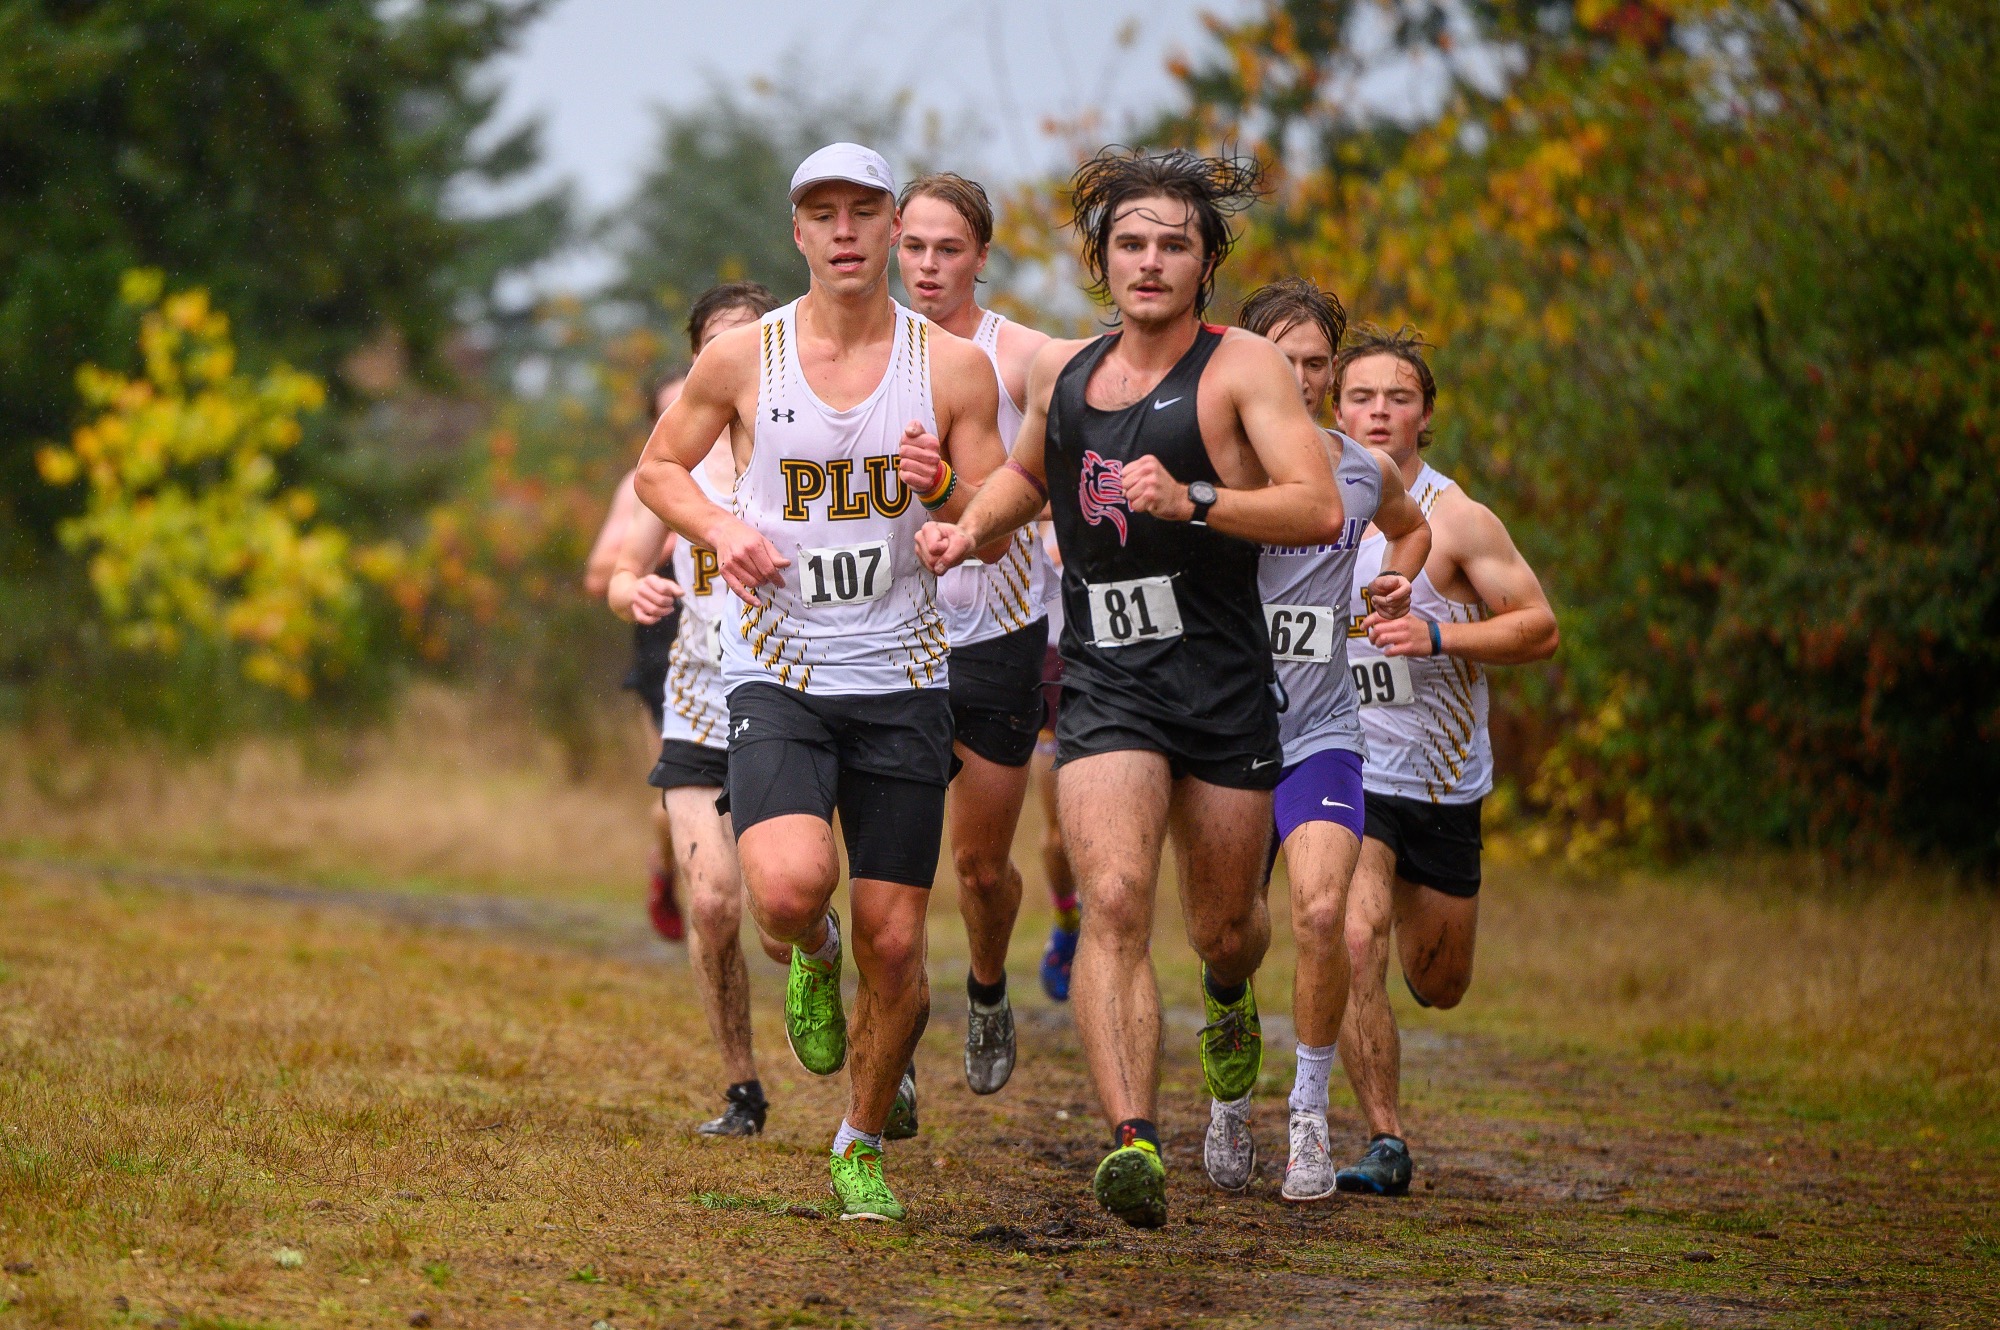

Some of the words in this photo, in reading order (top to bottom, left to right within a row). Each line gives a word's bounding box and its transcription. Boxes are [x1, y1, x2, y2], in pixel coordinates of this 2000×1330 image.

[780, 454, 912, 522] PLU
[808, 547, 882, 603] 107
[1104, 585, 1159, 640] 81
[1270, 610, 1317, 656] 62
[1351, 661, 1395, 705] 99
